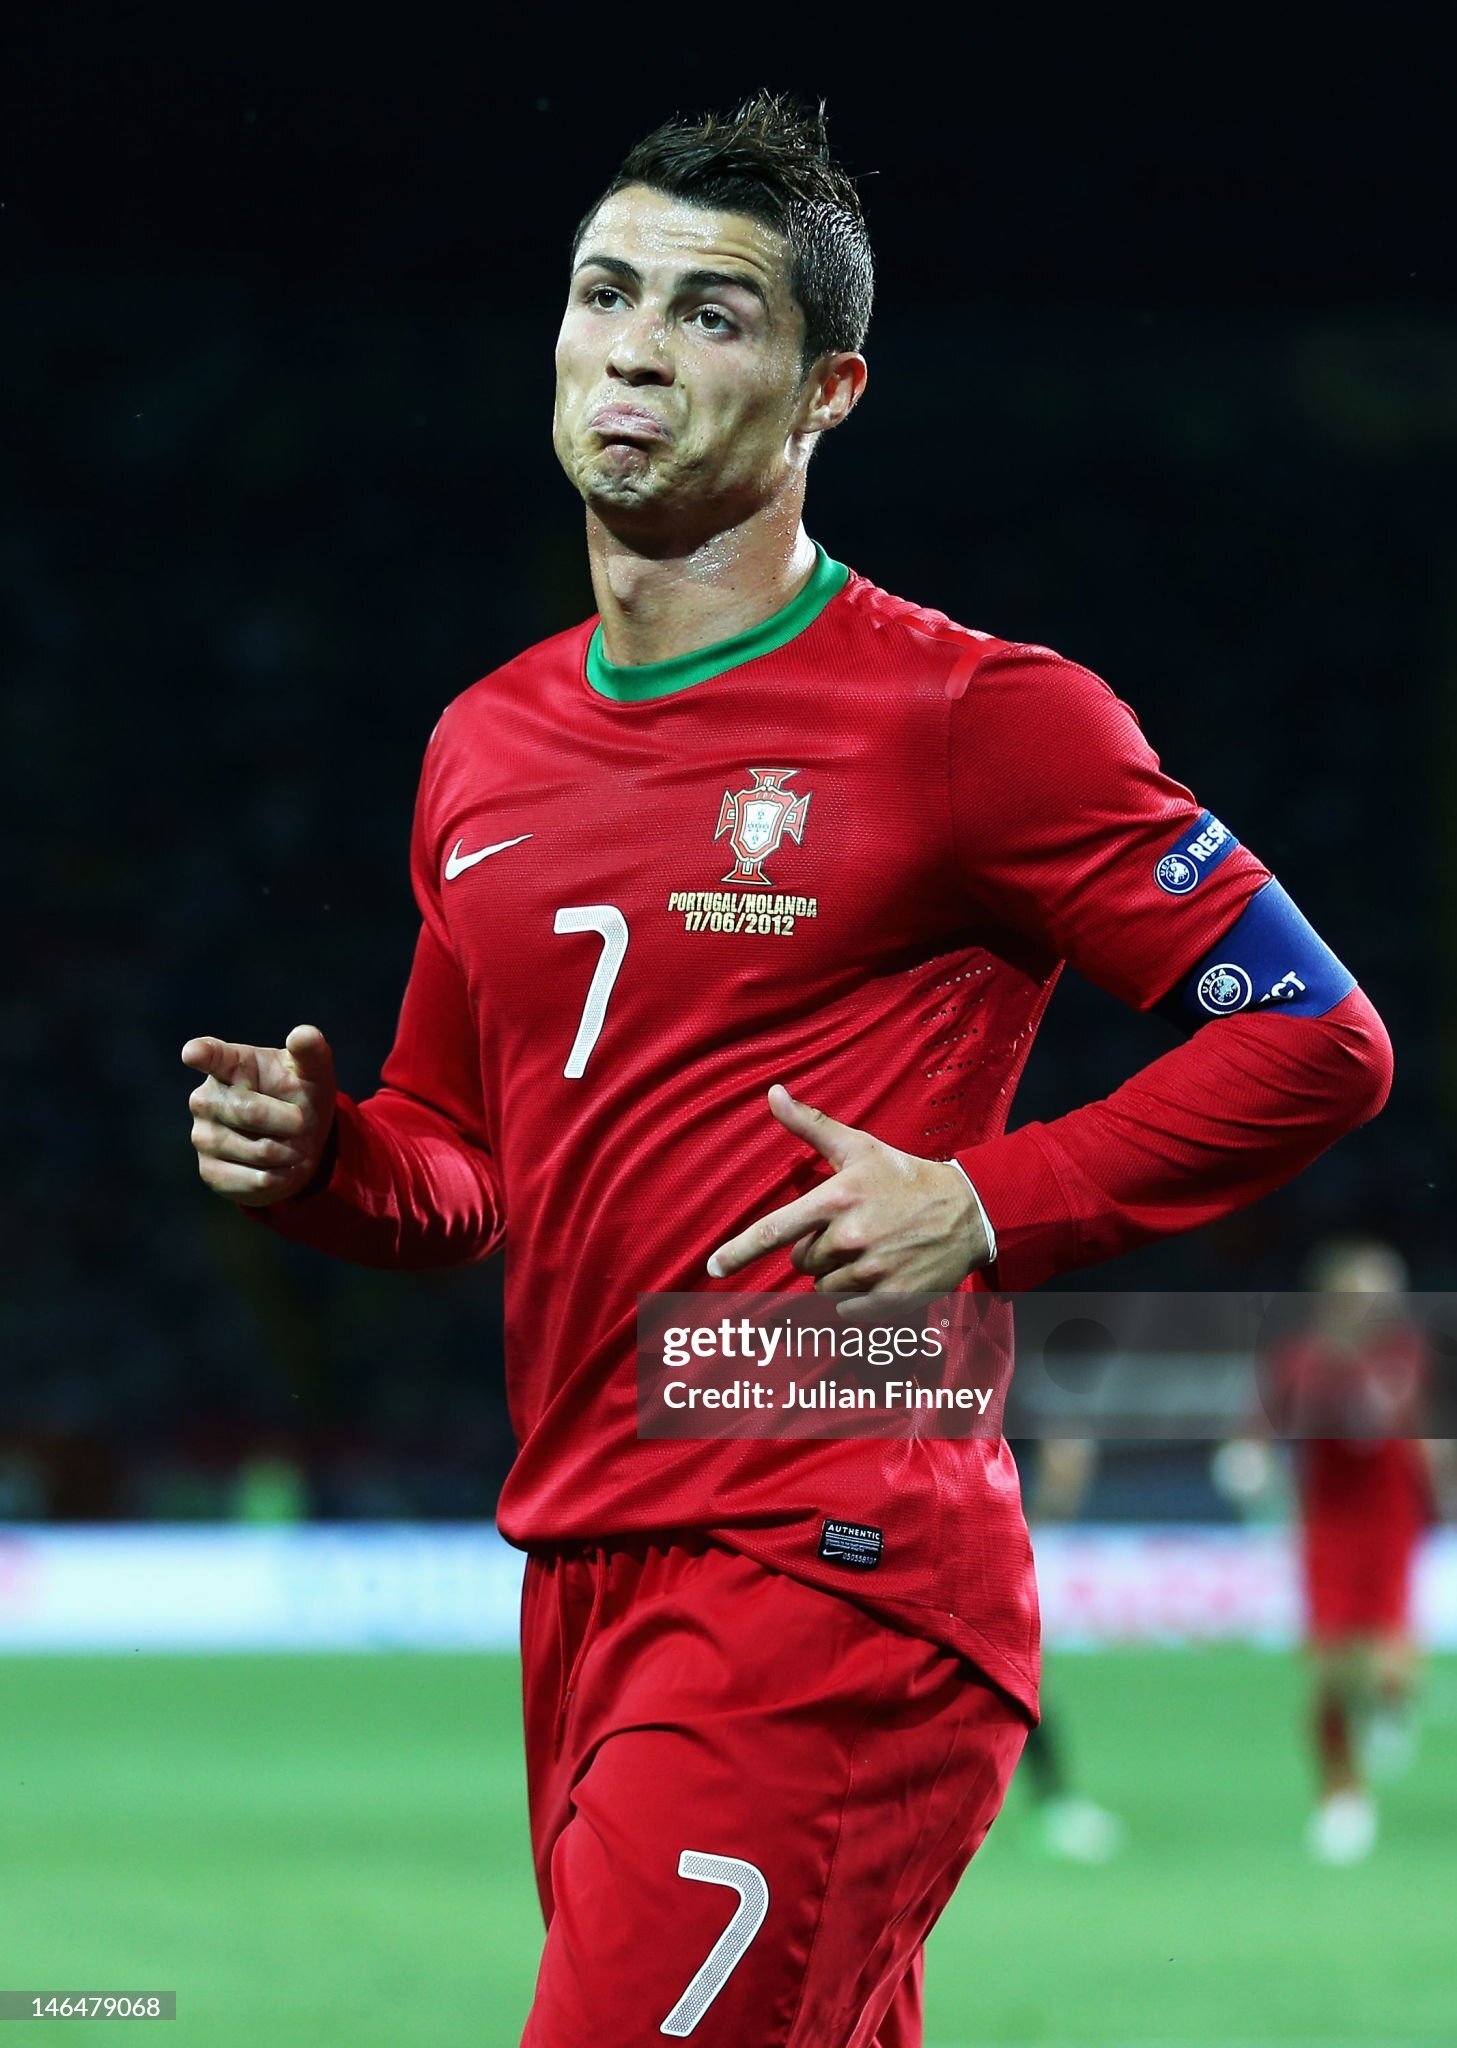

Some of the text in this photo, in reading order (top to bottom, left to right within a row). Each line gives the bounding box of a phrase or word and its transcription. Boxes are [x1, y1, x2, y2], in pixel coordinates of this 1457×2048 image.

[1160, 857, 1178, 877] UEFA
[667, 891, 818, 918] PORTUGAL/HOLANDA
[684, 911, 795, 936] 17/06/2012
[553, 904, 630, 1080] 7
[1202, 968, 1227, 994] UEFA
[828, 1524, 880, 1540] AUTHENTIC
[659, 1849, 770, 2038] 7
